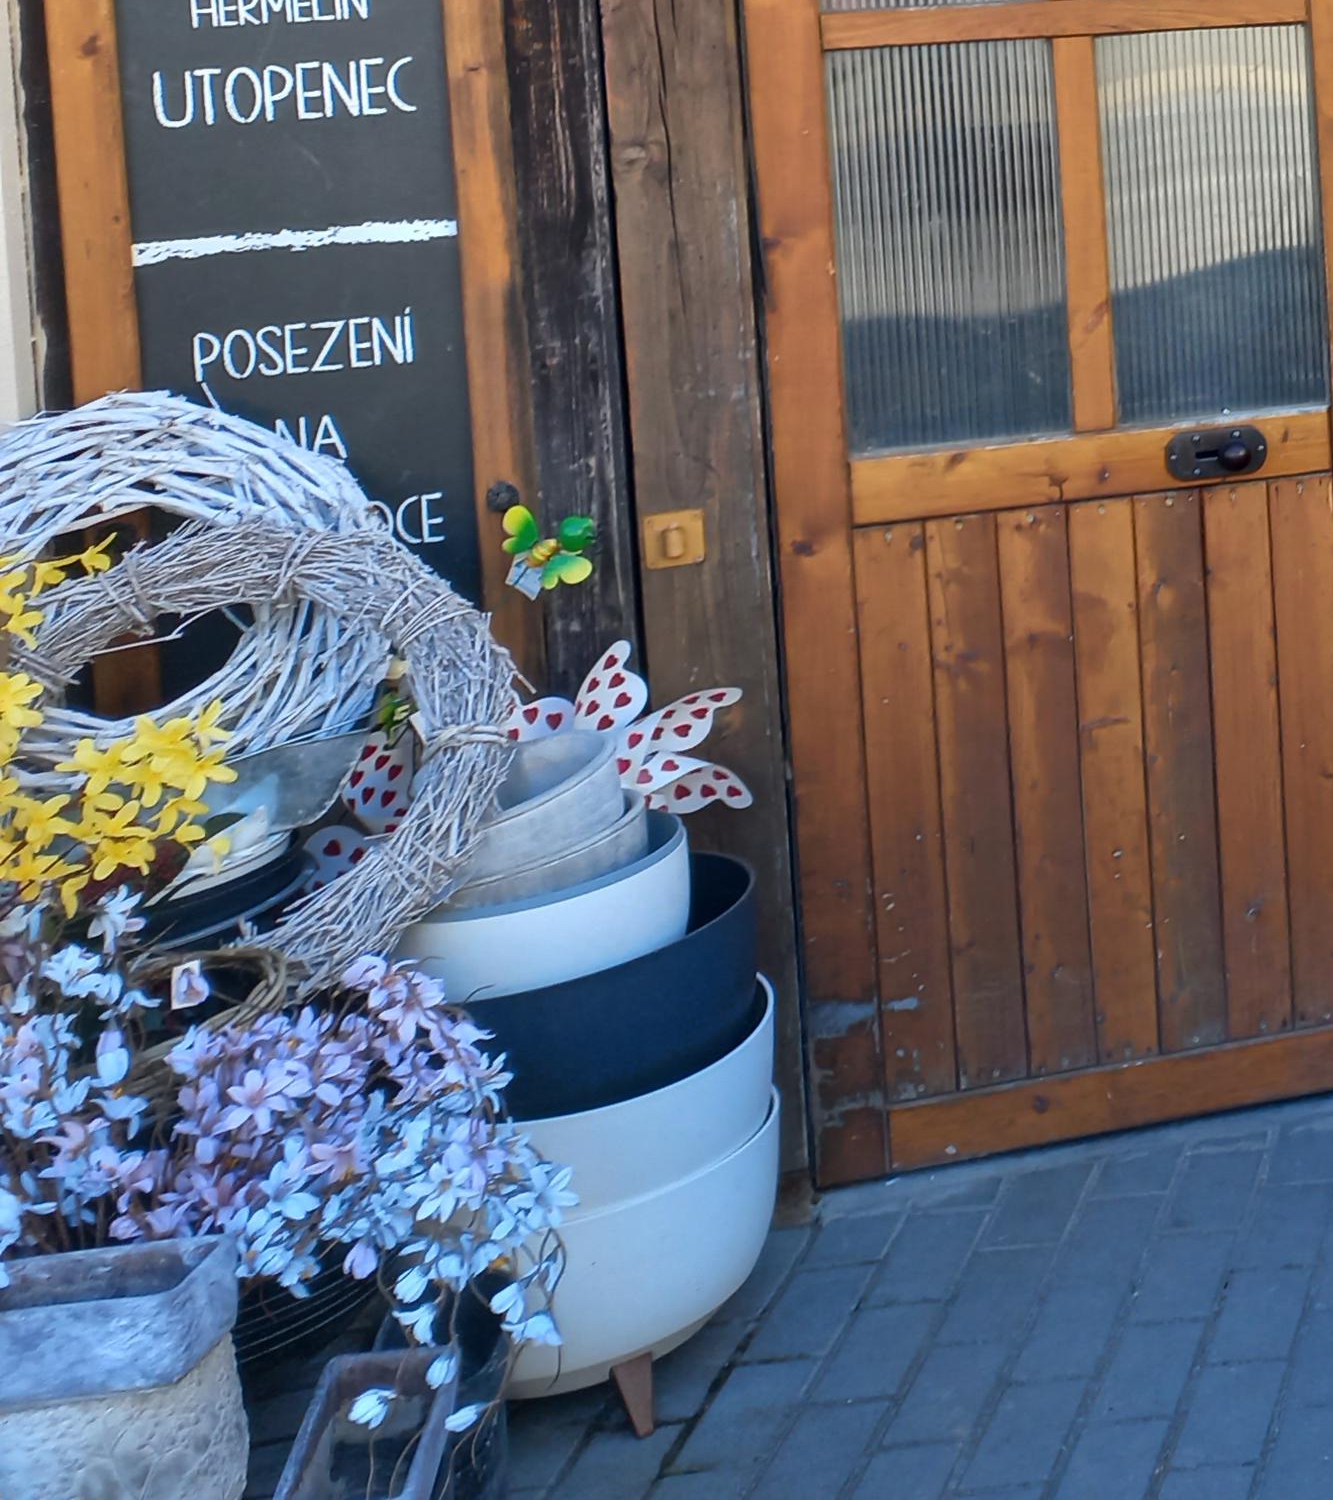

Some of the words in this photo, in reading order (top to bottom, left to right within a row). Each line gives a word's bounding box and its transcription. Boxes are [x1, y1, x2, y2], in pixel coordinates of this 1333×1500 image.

[152, 56, 417, 129] UTOPENEC
[192, 306, 415, 382] POSEZENÍ
[275, 414, 348, 459] NA
